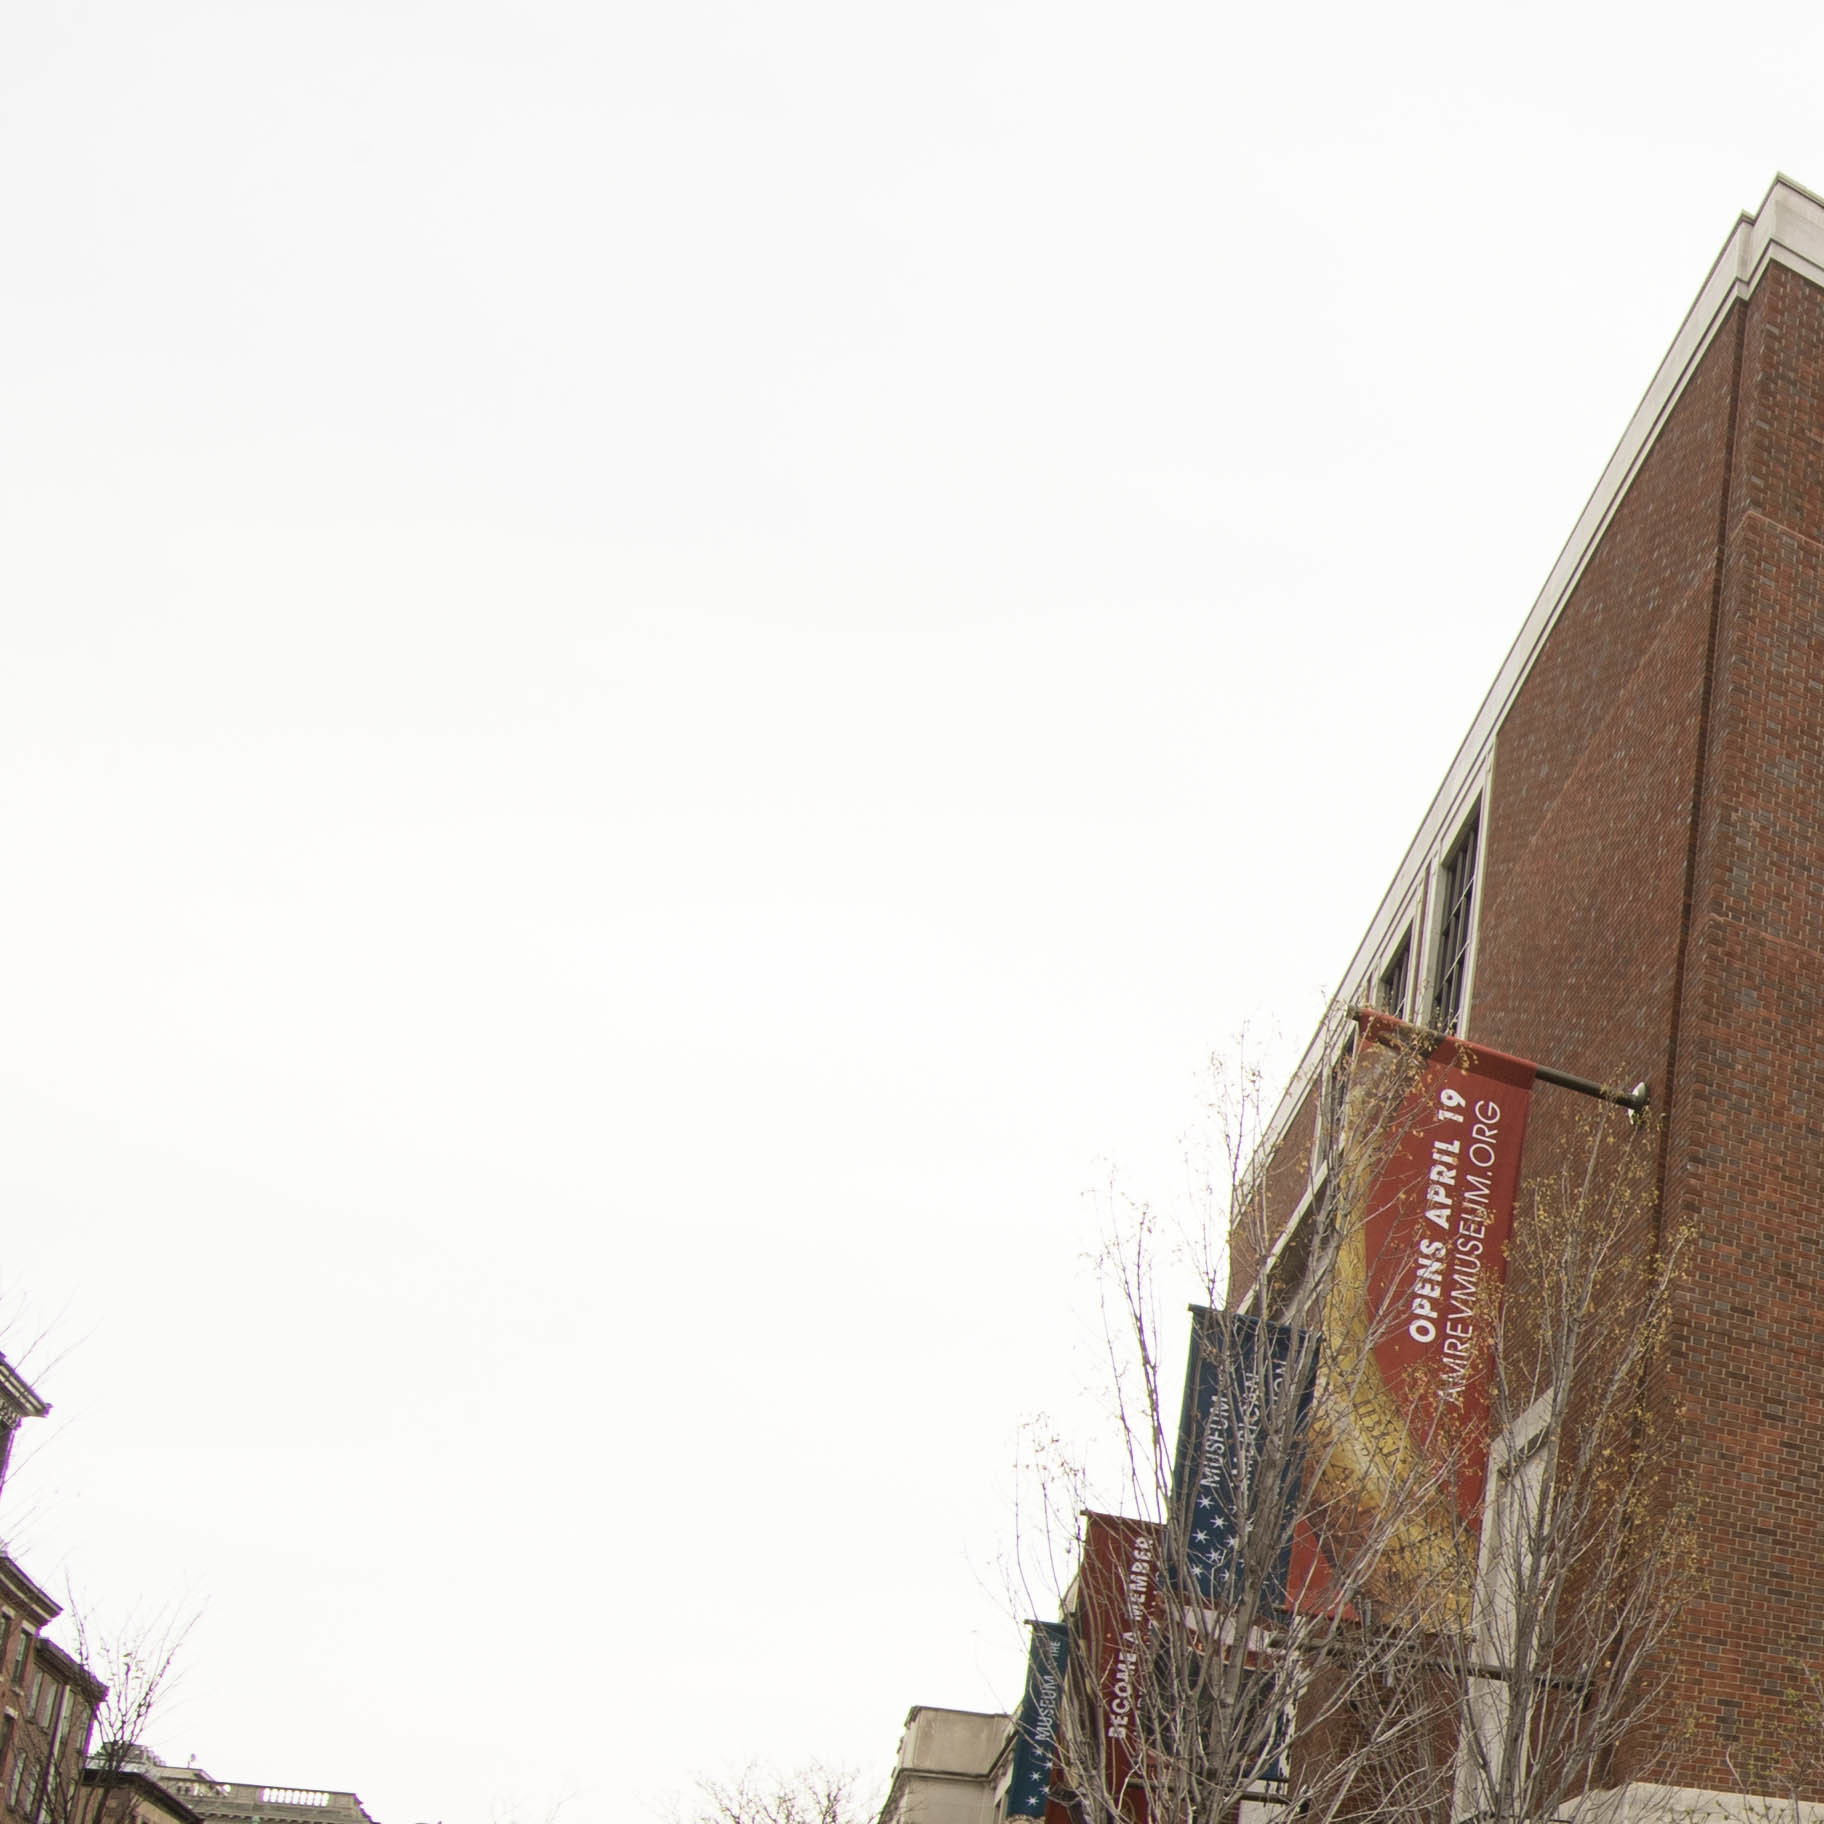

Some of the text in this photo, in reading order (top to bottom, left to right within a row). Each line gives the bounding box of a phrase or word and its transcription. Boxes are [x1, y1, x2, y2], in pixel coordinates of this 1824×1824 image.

[1407, 1087, 1467, 1344] OPENS APRIL 19
[1437, 1099, 1502, 1405] AMREVMUSEUM.ORG
[1128, 1537, 1153, 1621] MEMBER
[1123, 1631, 1139, 1644] A
[1035, 1675, 1057, 1740] MUSEUM
[1109, 1651, 1137, 1739] BECOME
